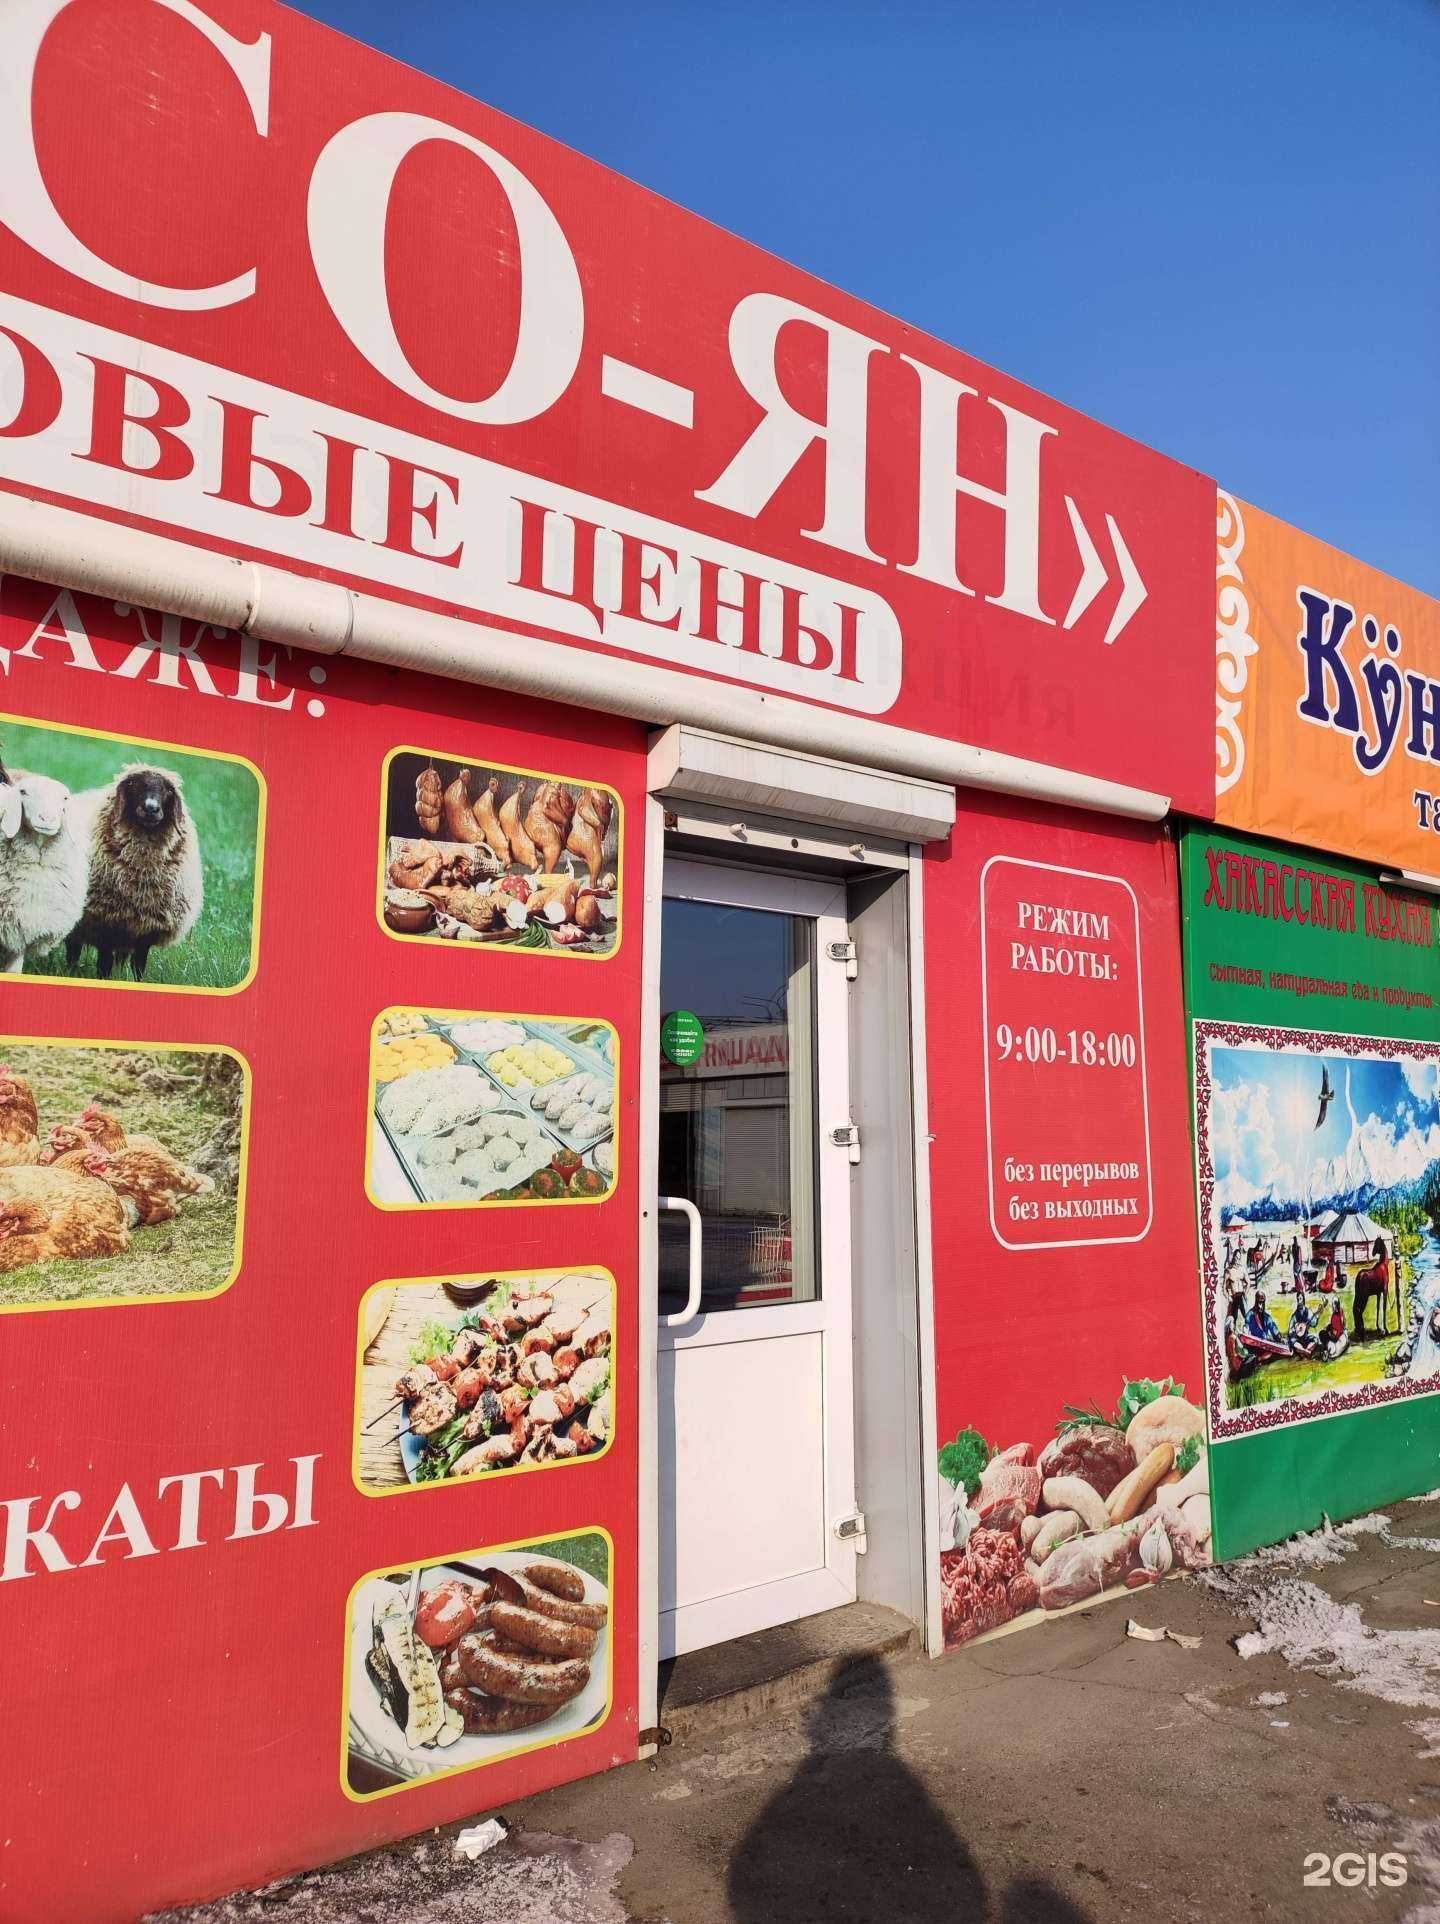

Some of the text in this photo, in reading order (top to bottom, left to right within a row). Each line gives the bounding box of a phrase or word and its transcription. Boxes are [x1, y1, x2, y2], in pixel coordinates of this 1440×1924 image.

[508, 495, 866, 684] ЦЕНЫ
[0, 588, 327, 718] АЖЕ:
[1204, 847, 1356, 935] ХАКАССКАЯ
[1016, 901, 1111, 941] РЕЖИМ
[1010, 942, 1119, 981] РАБОТЫ:
[996, 1024, 1137, 1068] 9:00-18:00
[1004, 1157, 1140, 1188] без перерывов
[1009, 1195, 1139, 1221] без выходных
[0, 1453, 323, 1581] КАТЫ
